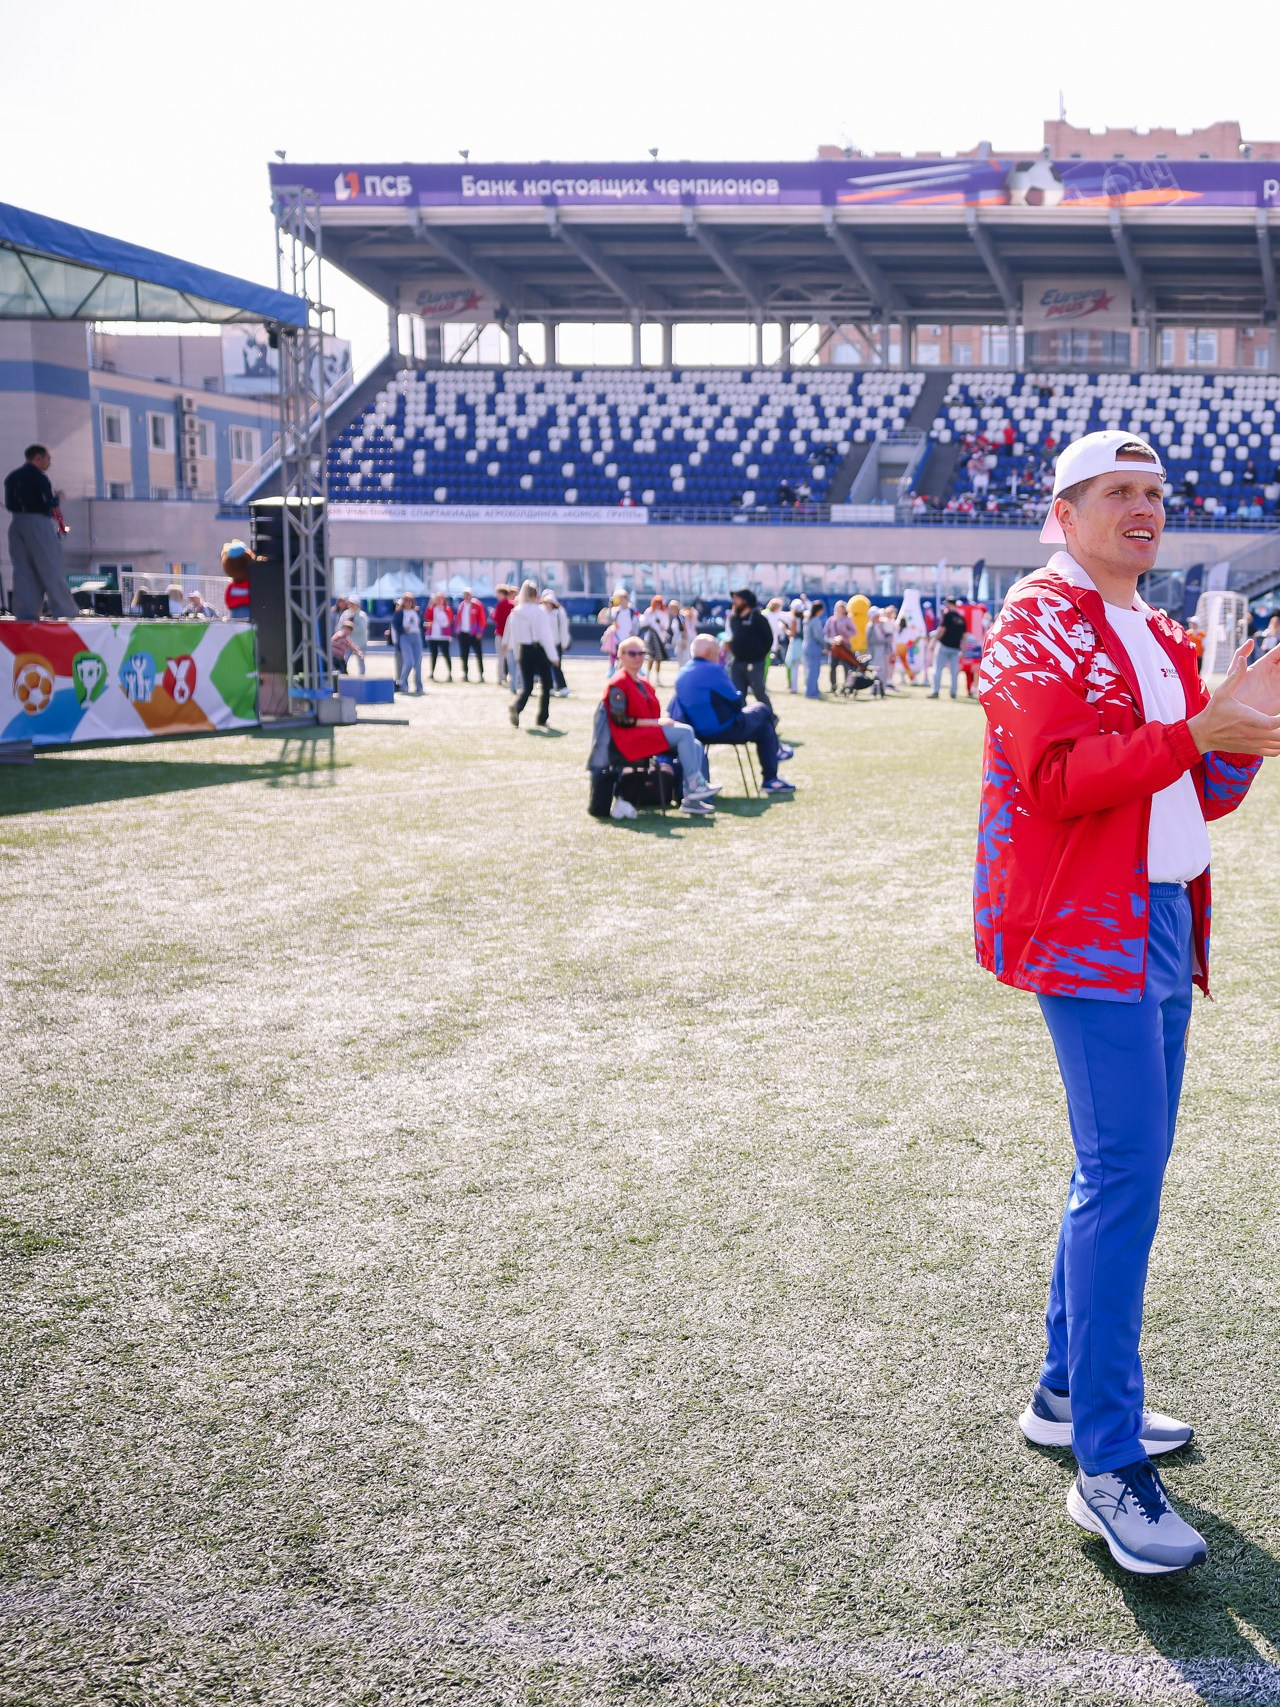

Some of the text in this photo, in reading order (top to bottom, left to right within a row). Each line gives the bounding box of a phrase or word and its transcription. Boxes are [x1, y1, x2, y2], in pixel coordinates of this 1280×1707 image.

[364, 175, 412, 197] ПСБ
[461, 174, 780, 199] Банк настоящих чемпионов
